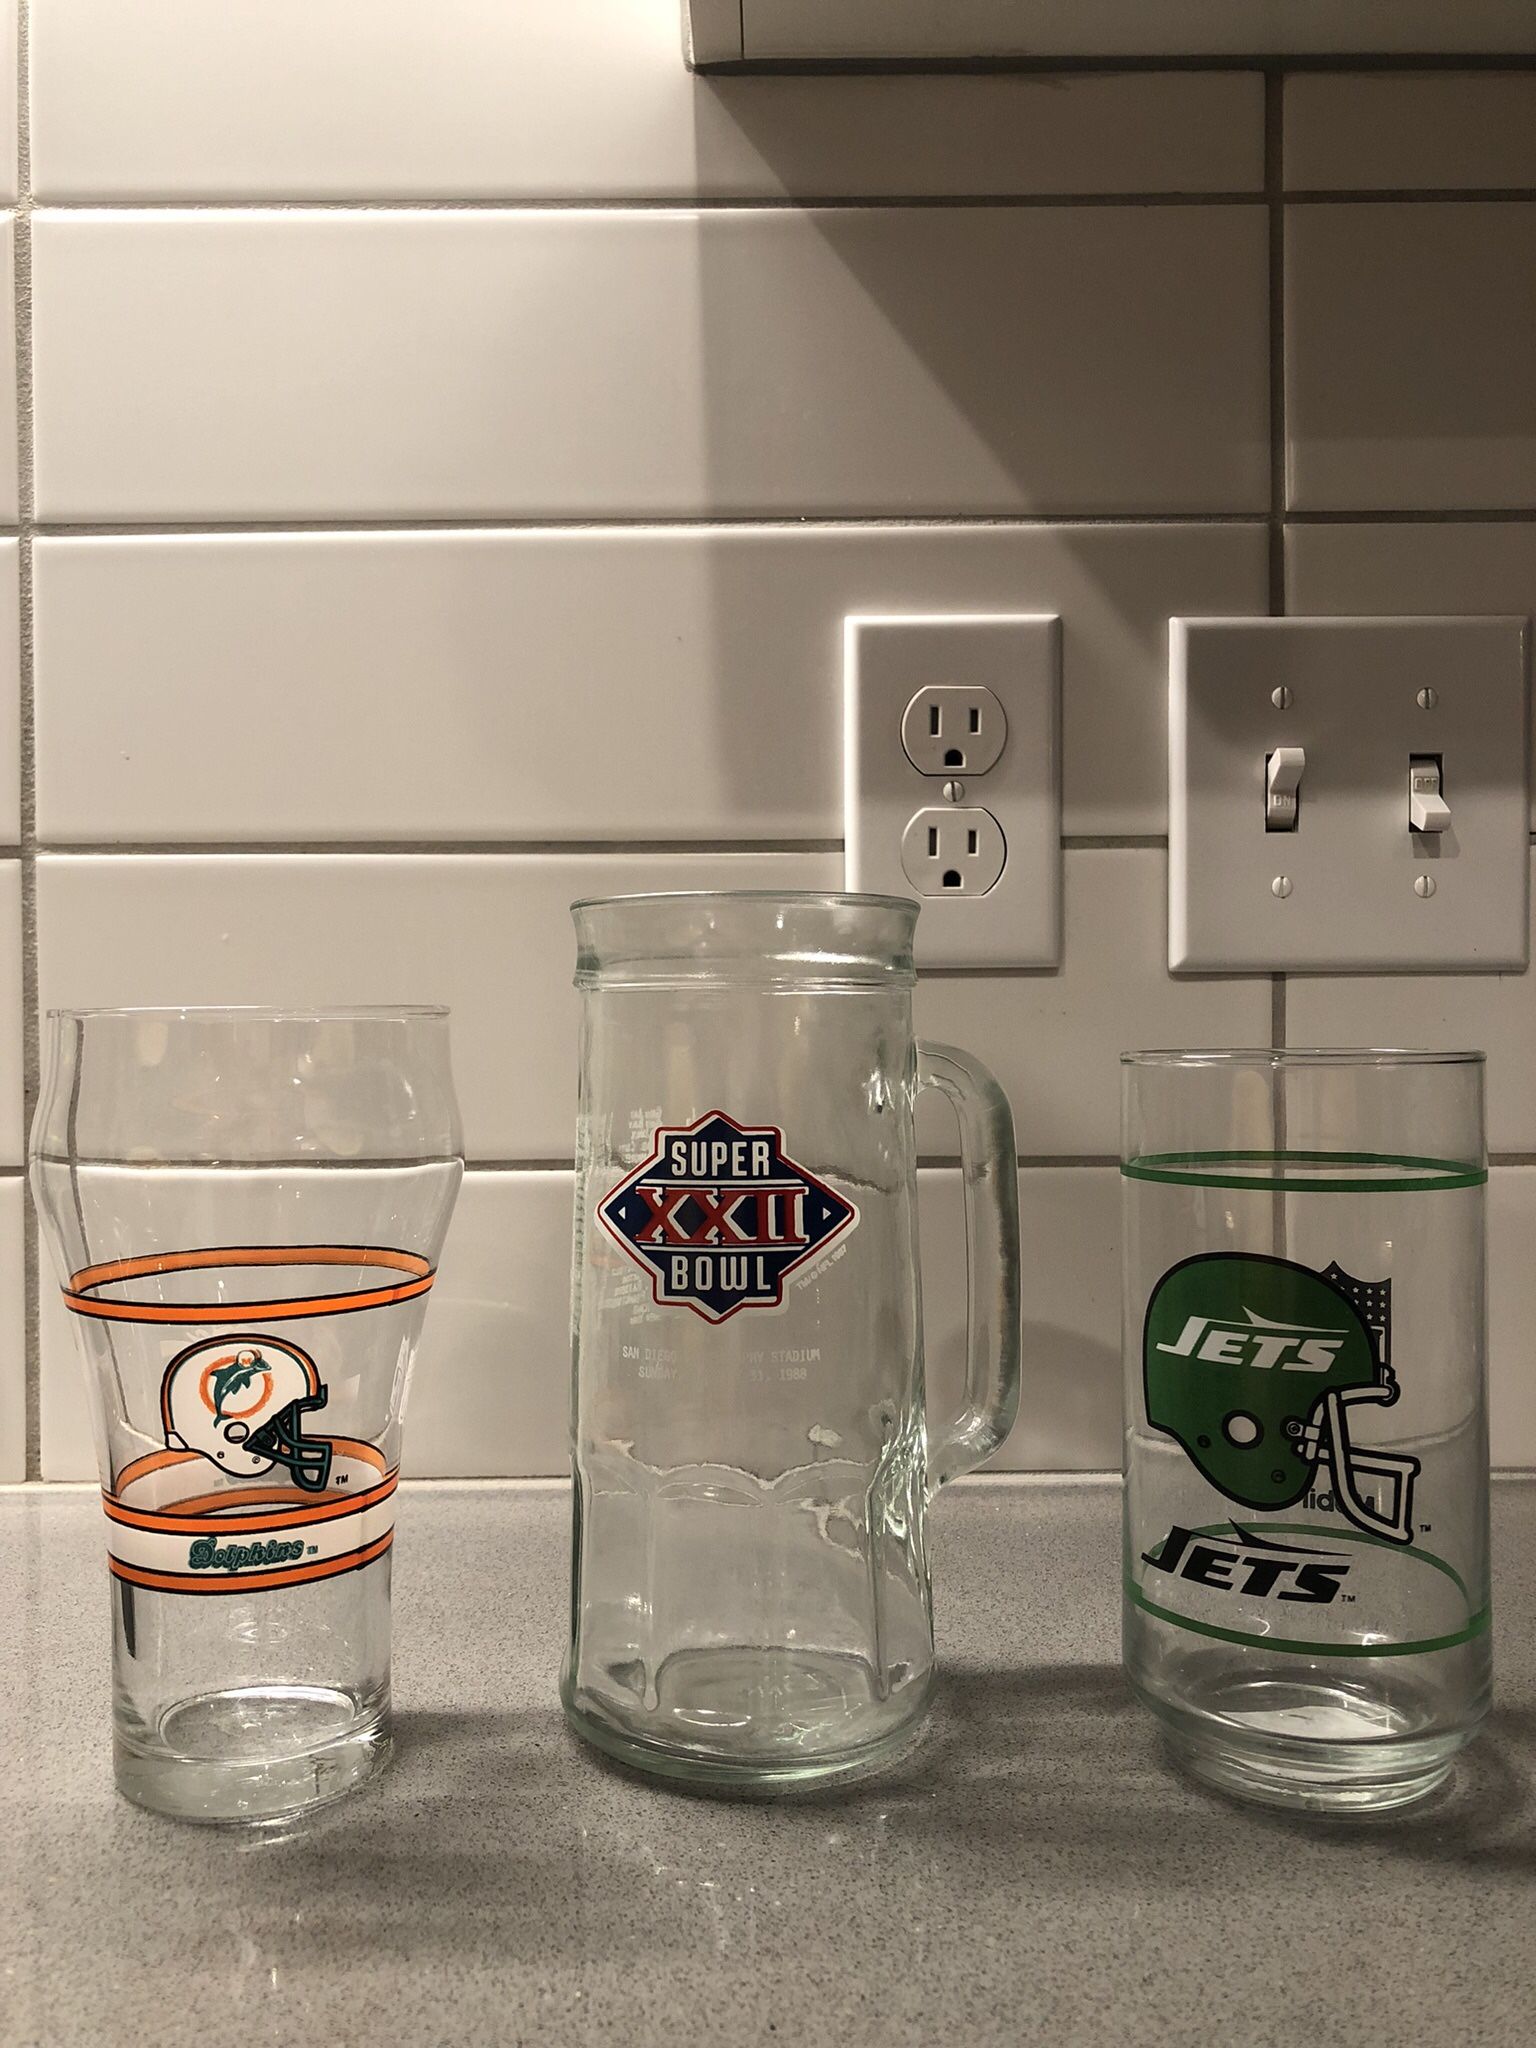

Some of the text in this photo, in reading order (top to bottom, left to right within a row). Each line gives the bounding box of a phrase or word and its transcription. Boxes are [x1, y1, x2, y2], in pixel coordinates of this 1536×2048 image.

[1273, 794, 1291, 807] ON
[671, 1141, 770, 1177] SUPER
[633, 1186, 811, 1245] XXII
[671, 1255, 772, 1291] BOWL
[622, 1345, 640, 1360] SAN
[771, 1348, 821, 1362] STADIUM
[1156, 1306, 1350, 1373] JETS
[779, 1367, 807, 1381] 1988
[336, 1474, 348, 1485] TM
[1419, 1524, 1432, 1533] TM
[188, 1536, 305, 1571] Dolphins
[1141, 1517, 1356, 1604] JETS TM
